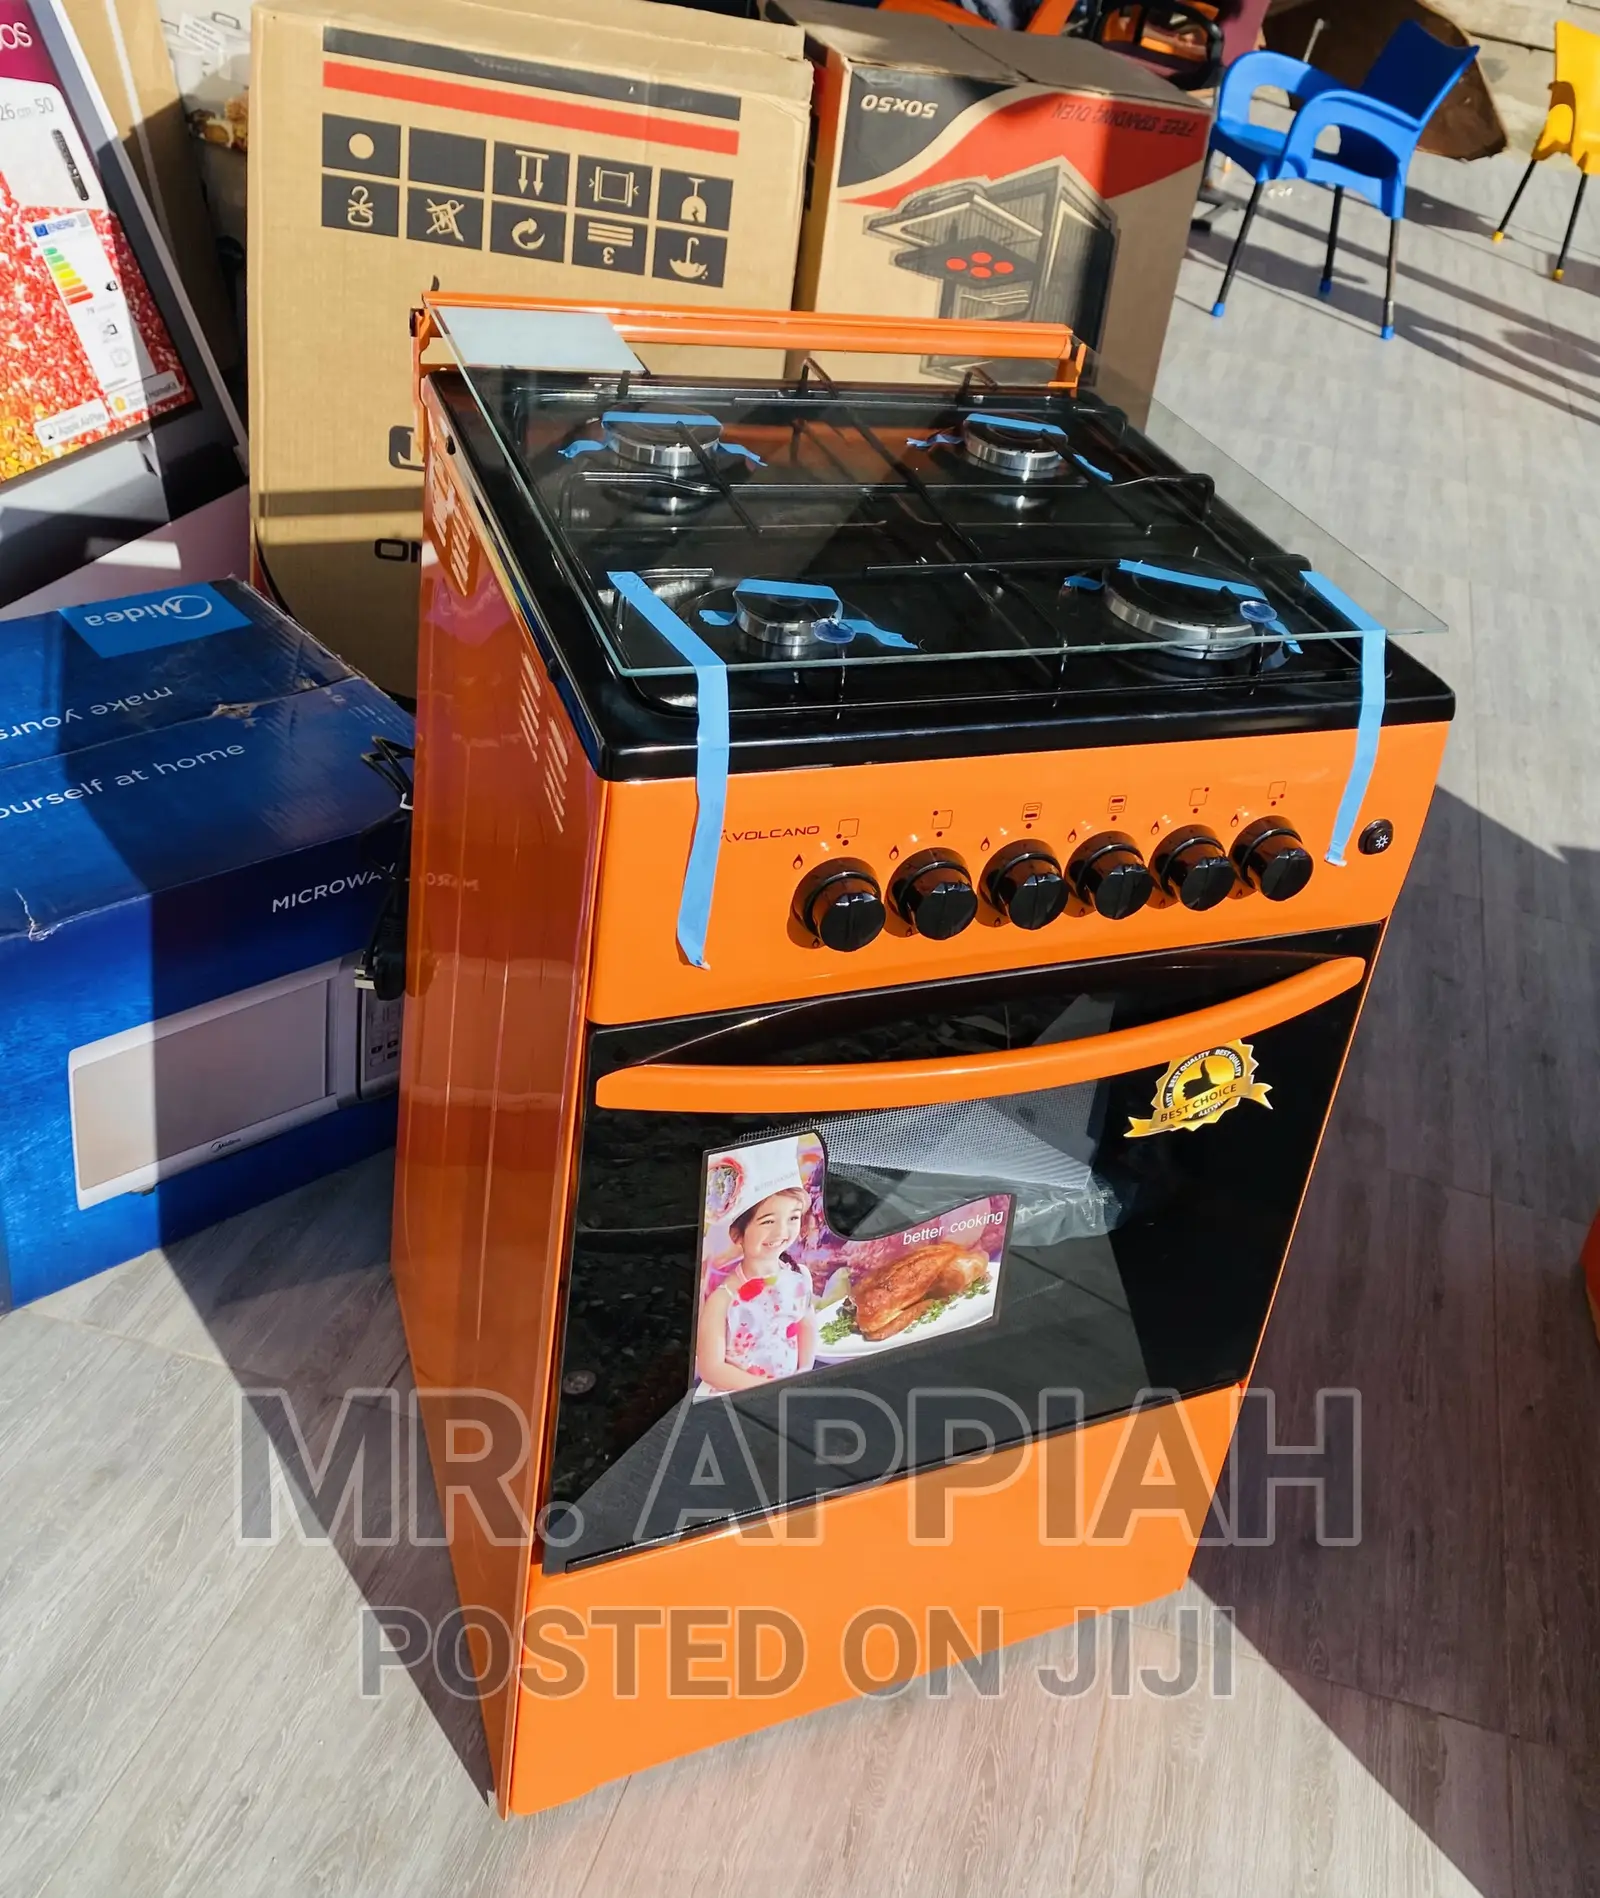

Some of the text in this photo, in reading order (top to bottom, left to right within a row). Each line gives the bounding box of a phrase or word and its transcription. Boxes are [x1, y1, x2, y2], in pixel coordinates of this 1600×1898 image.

[0, 21, 33, 51] OS
[84, 594, 213, 627] Midea
[90, 686, 174, 716] make
[115, 769, 149, 786] at
[153, 744, 246, 775] home
[732, 825, 820, 842] VOLCANO
[1179, 1050, 1211, 1072] QUALITY
[1160, 1083, 1237, 1123] BEST CHOICE
[903, 1210, 1004, 1246] better cooking
